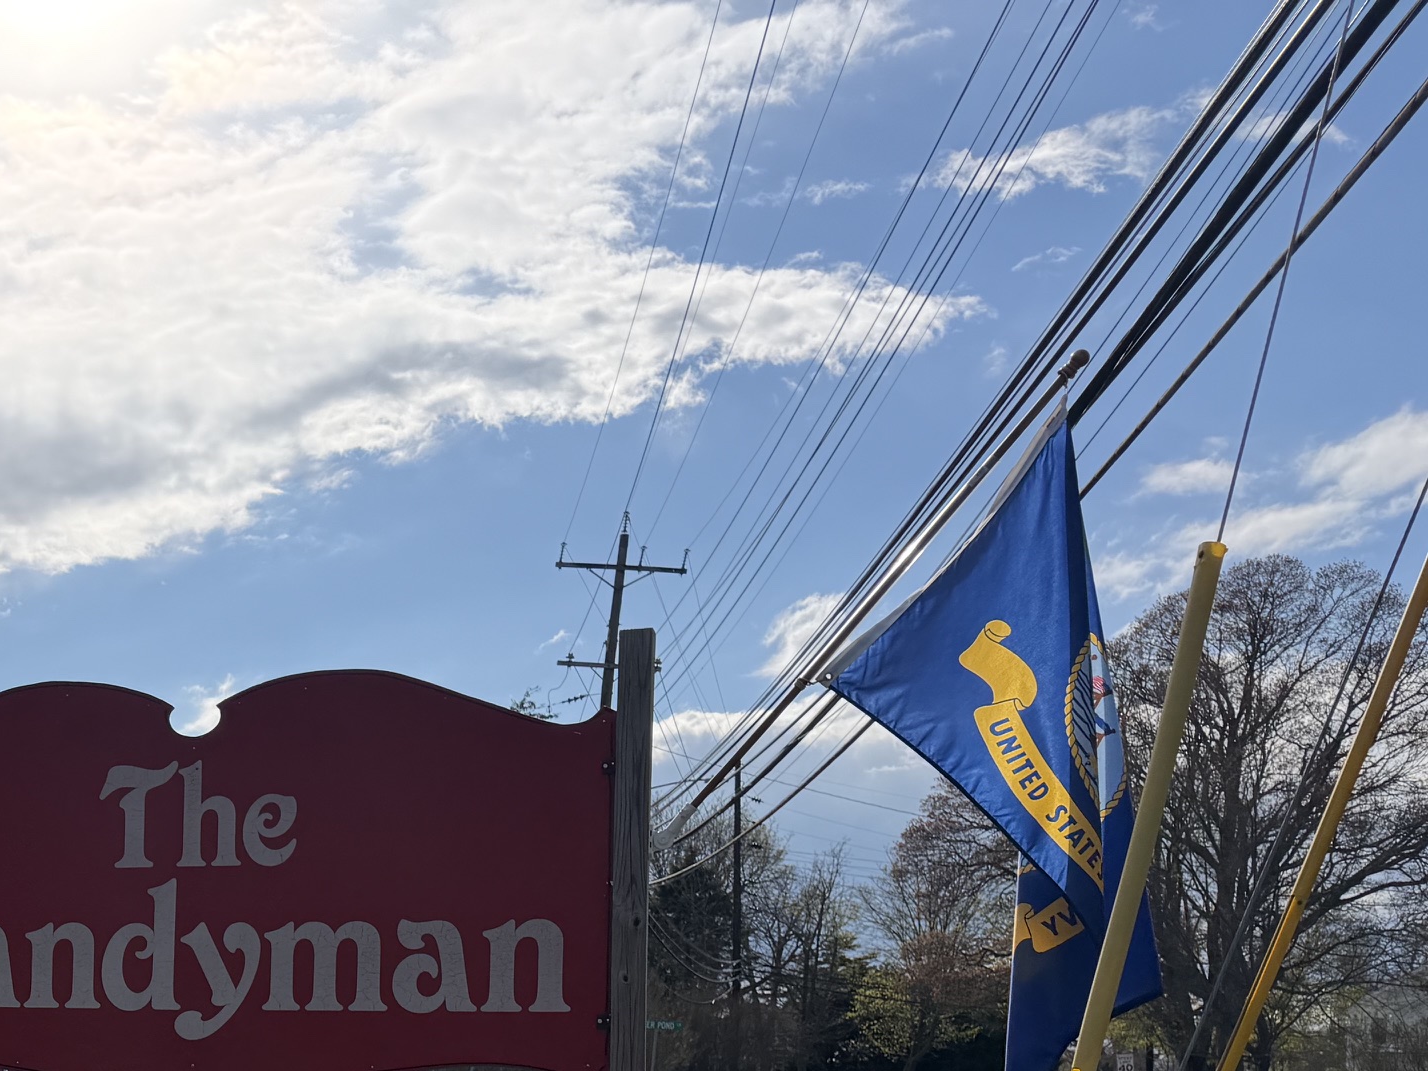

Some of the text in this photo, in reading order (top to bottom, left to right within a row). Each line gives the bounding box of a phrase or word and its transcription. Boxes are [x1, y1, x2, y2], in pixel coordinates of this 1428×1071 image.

[989, 717, 1050, 801] UNITED
[99, 760, 298, 869] The
[646, 1020, 655, 1029] ER
[657, 1021, 675, 1030] POND
[1118, 1063, 1134, 1071] 40
